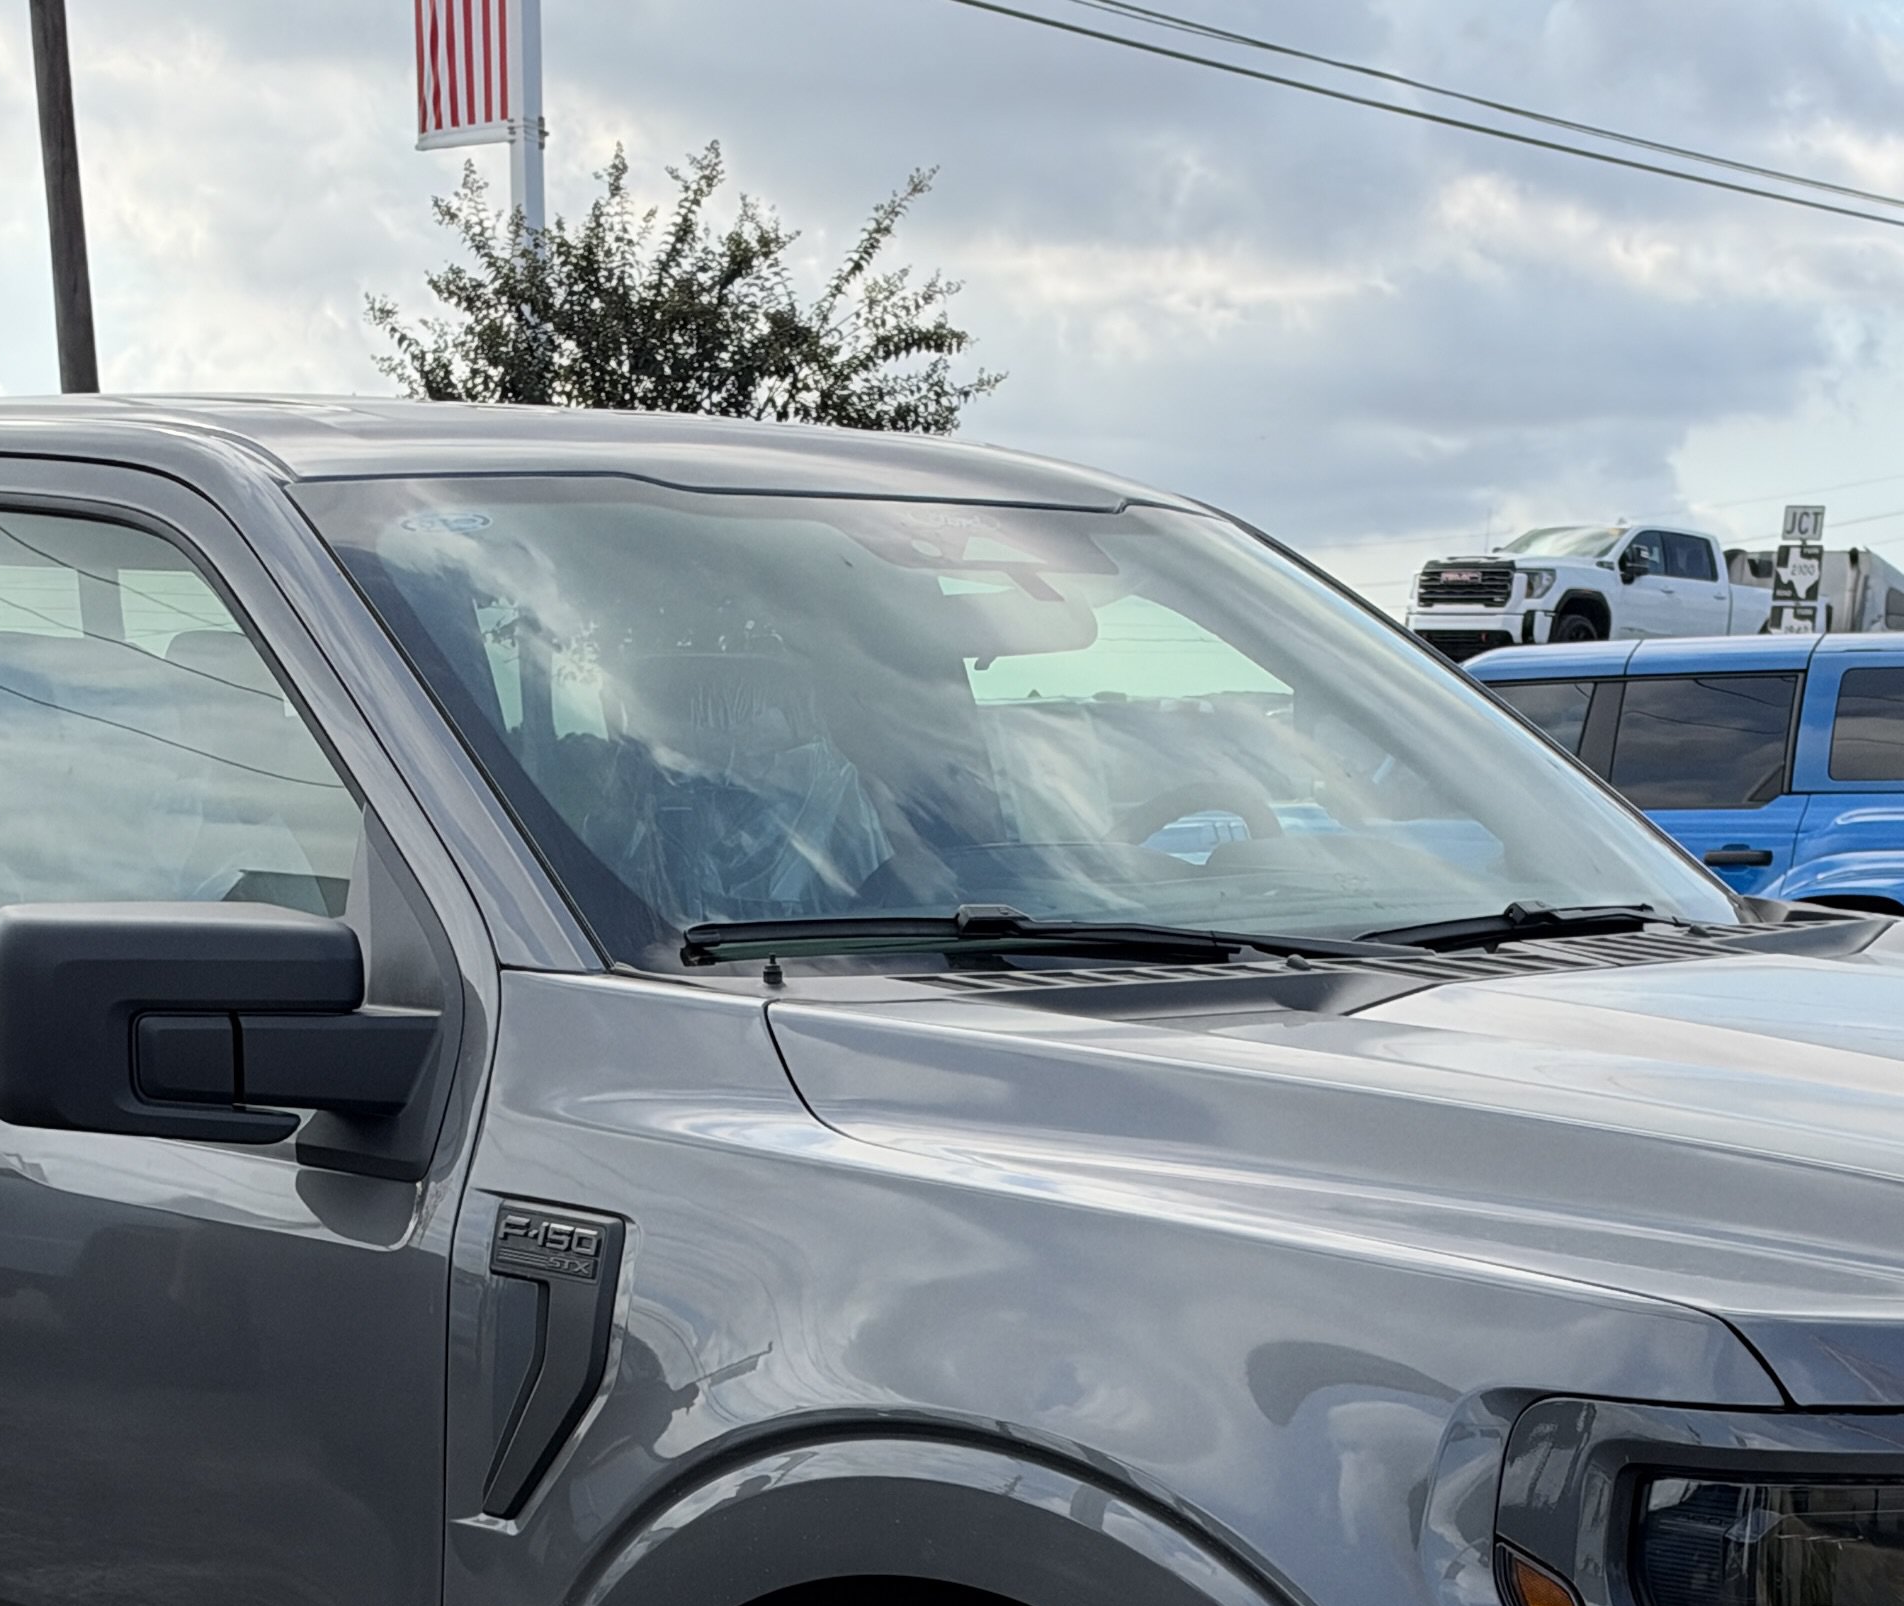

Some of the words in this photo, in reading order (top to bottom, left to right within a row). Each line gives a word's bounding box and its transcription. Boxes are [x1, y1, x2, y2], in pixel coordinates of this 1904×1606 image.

[1785, 511, 1824, 535] JCT
[1790, 564, 1815, 576] 2100
[498, 1214, 599, 1255] F-150
[547, 1256, 590, 1274] STX
